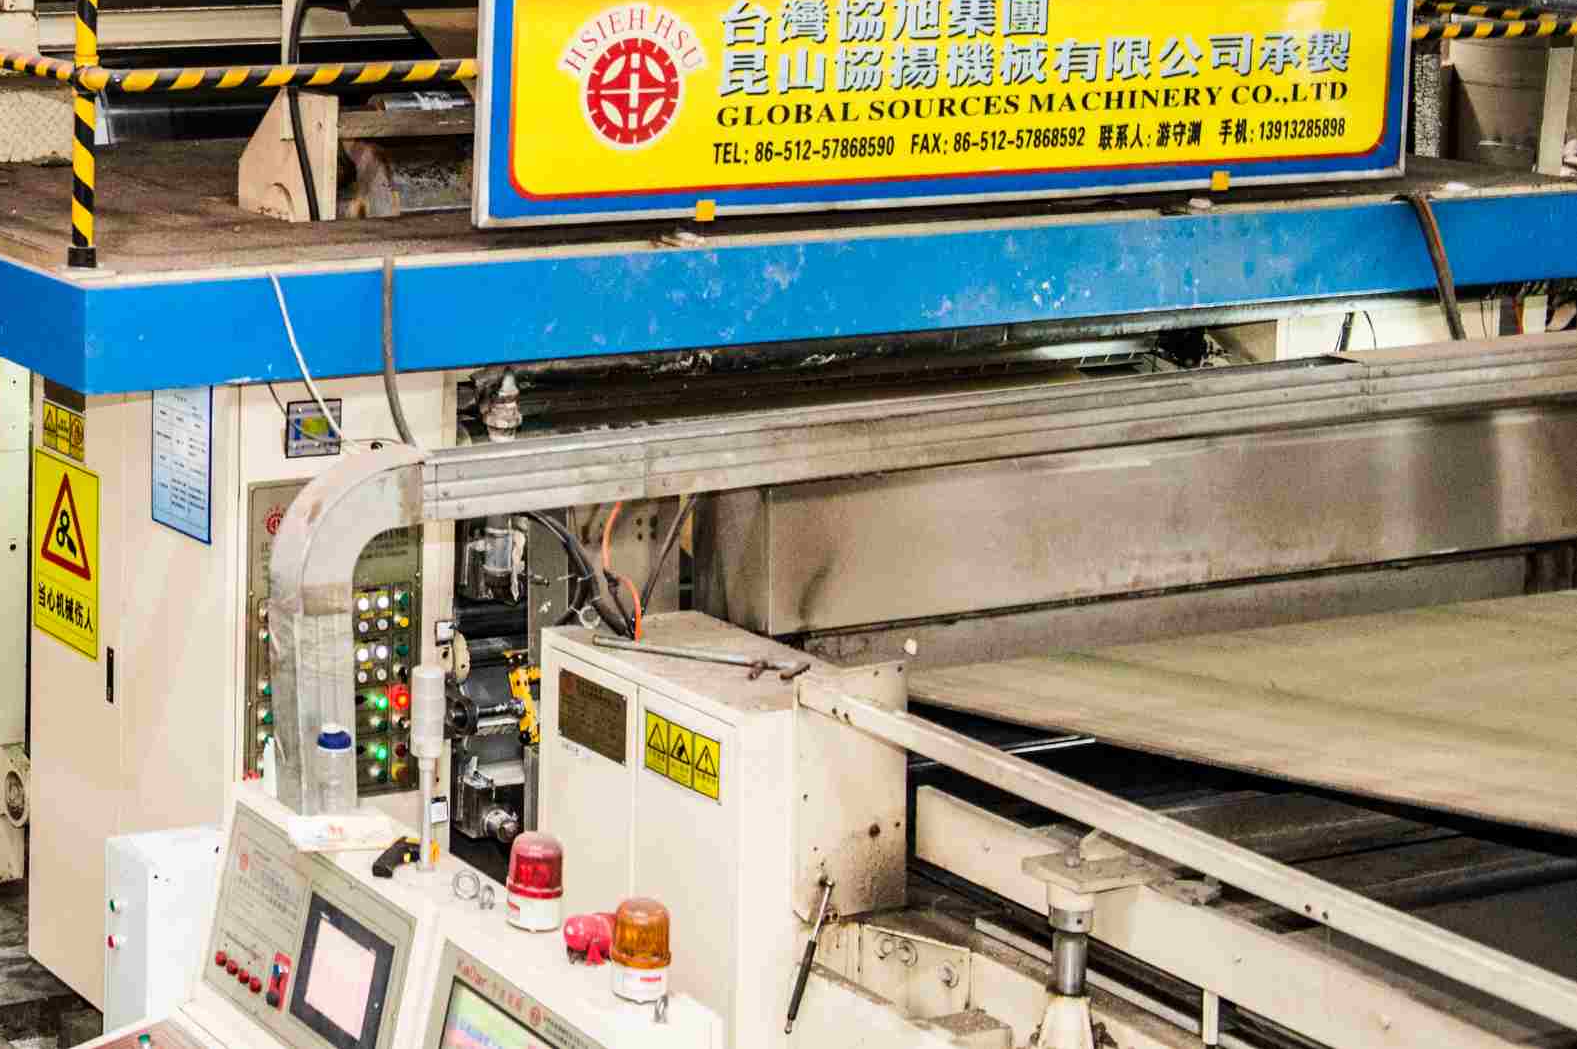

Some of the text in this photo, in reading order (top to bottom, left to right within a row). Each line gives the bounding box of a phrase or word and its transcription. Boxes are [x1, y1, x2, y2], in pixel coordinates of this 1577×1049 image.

[564, 8, 703, 73] HSIEH HSU
[718, 30, 1350, 97] 昆山協揚機械有限公司承製
[715, 80, 1348, 128] GLOBAL SOURCES MACHINERY CO.,LTD
[754, 135, 895, 163] 86-512-57868590
[952, 126, 1085, 153] 86-512-57868592
[38, 581, 94, 634] 当心机械伤人
